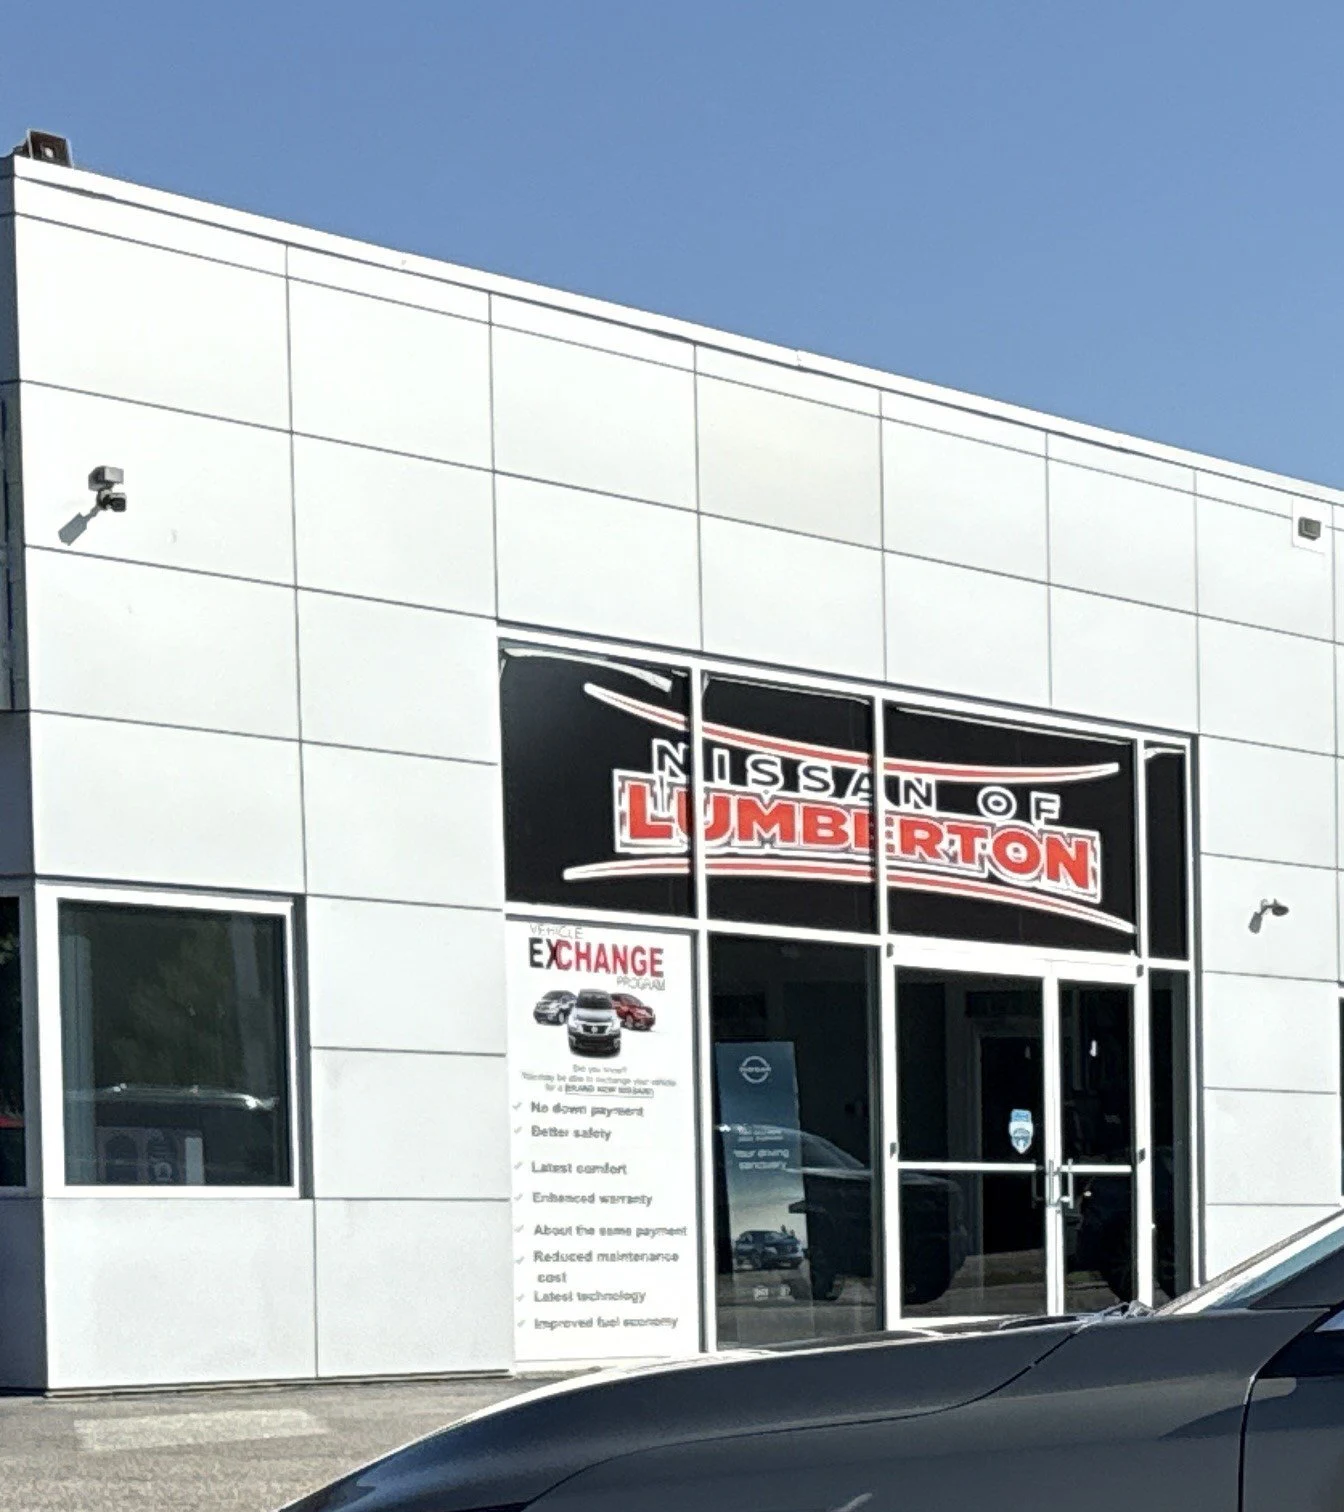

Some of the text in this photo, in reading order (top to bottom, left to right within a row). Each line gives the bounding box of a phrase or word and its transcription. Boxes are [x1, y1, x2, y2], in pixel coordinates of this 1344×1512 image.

[652, 738, 1060, 827] NISSAN OF
[622, 777, 1097, 895] LUMBERTON
[530, 924, 584, 939] VEHICLE
[529, 937, 664, 977] EXCHANGE
[616, 975, 665, 991] PROGRAM
[531, 1101, 644, 1118] No down payment
[531, 1125, 612, 1141] Better safety
[531, 1161, 628, 1175] Latest comfort
[532, 1191, 653, 1207] Enhanced warranty
[533, 1224, 688, 1239] About the same payment
[533, 1250, 680, 1263] Reduced maintenance
[536, 1271, 568, 1284] cost
[533, 1290, 647, 1304] Latest technology
[534, 1316, 679, 1331] Improved fuel economy
